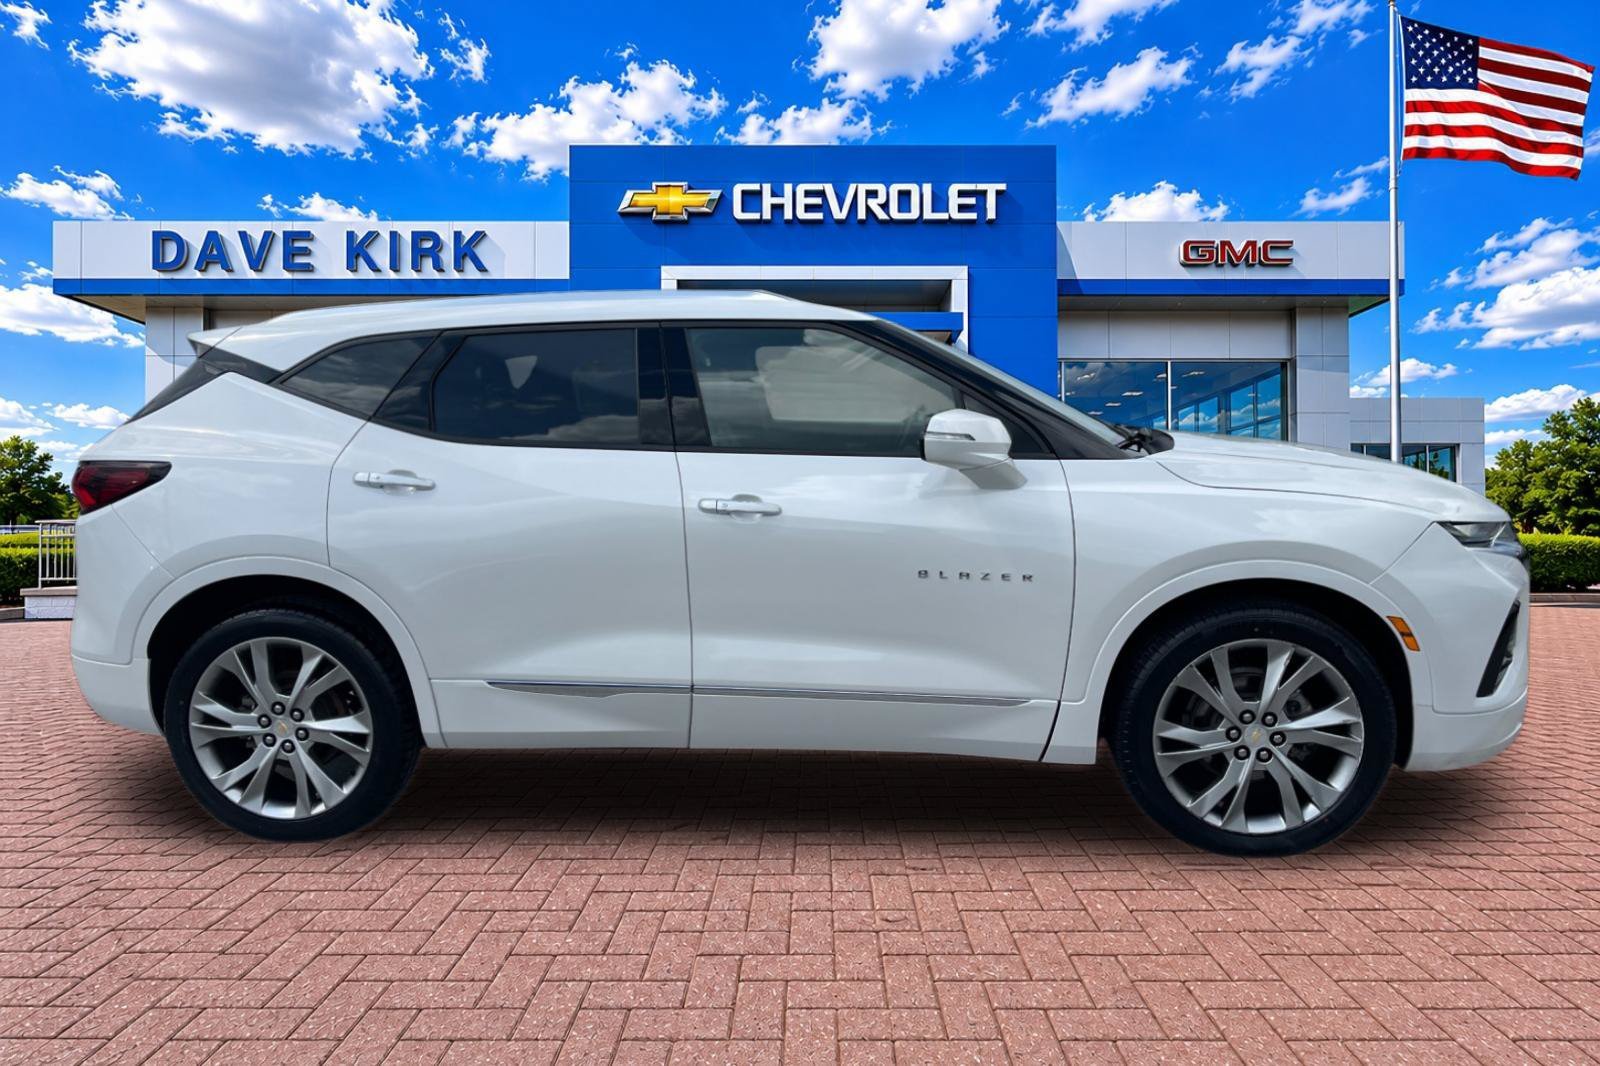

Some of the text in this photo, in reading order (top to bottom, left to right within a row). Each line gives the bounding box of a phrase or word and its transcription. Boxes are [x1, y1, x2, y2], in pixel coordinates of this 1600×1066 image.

[732, 182, 1008, 221] CHEVROLET
[151, 229, 489, 272] DAVE KIRK
[1180, 239, 1295, 267] GMC
[917, 569, 1034, 582] BLAZER
